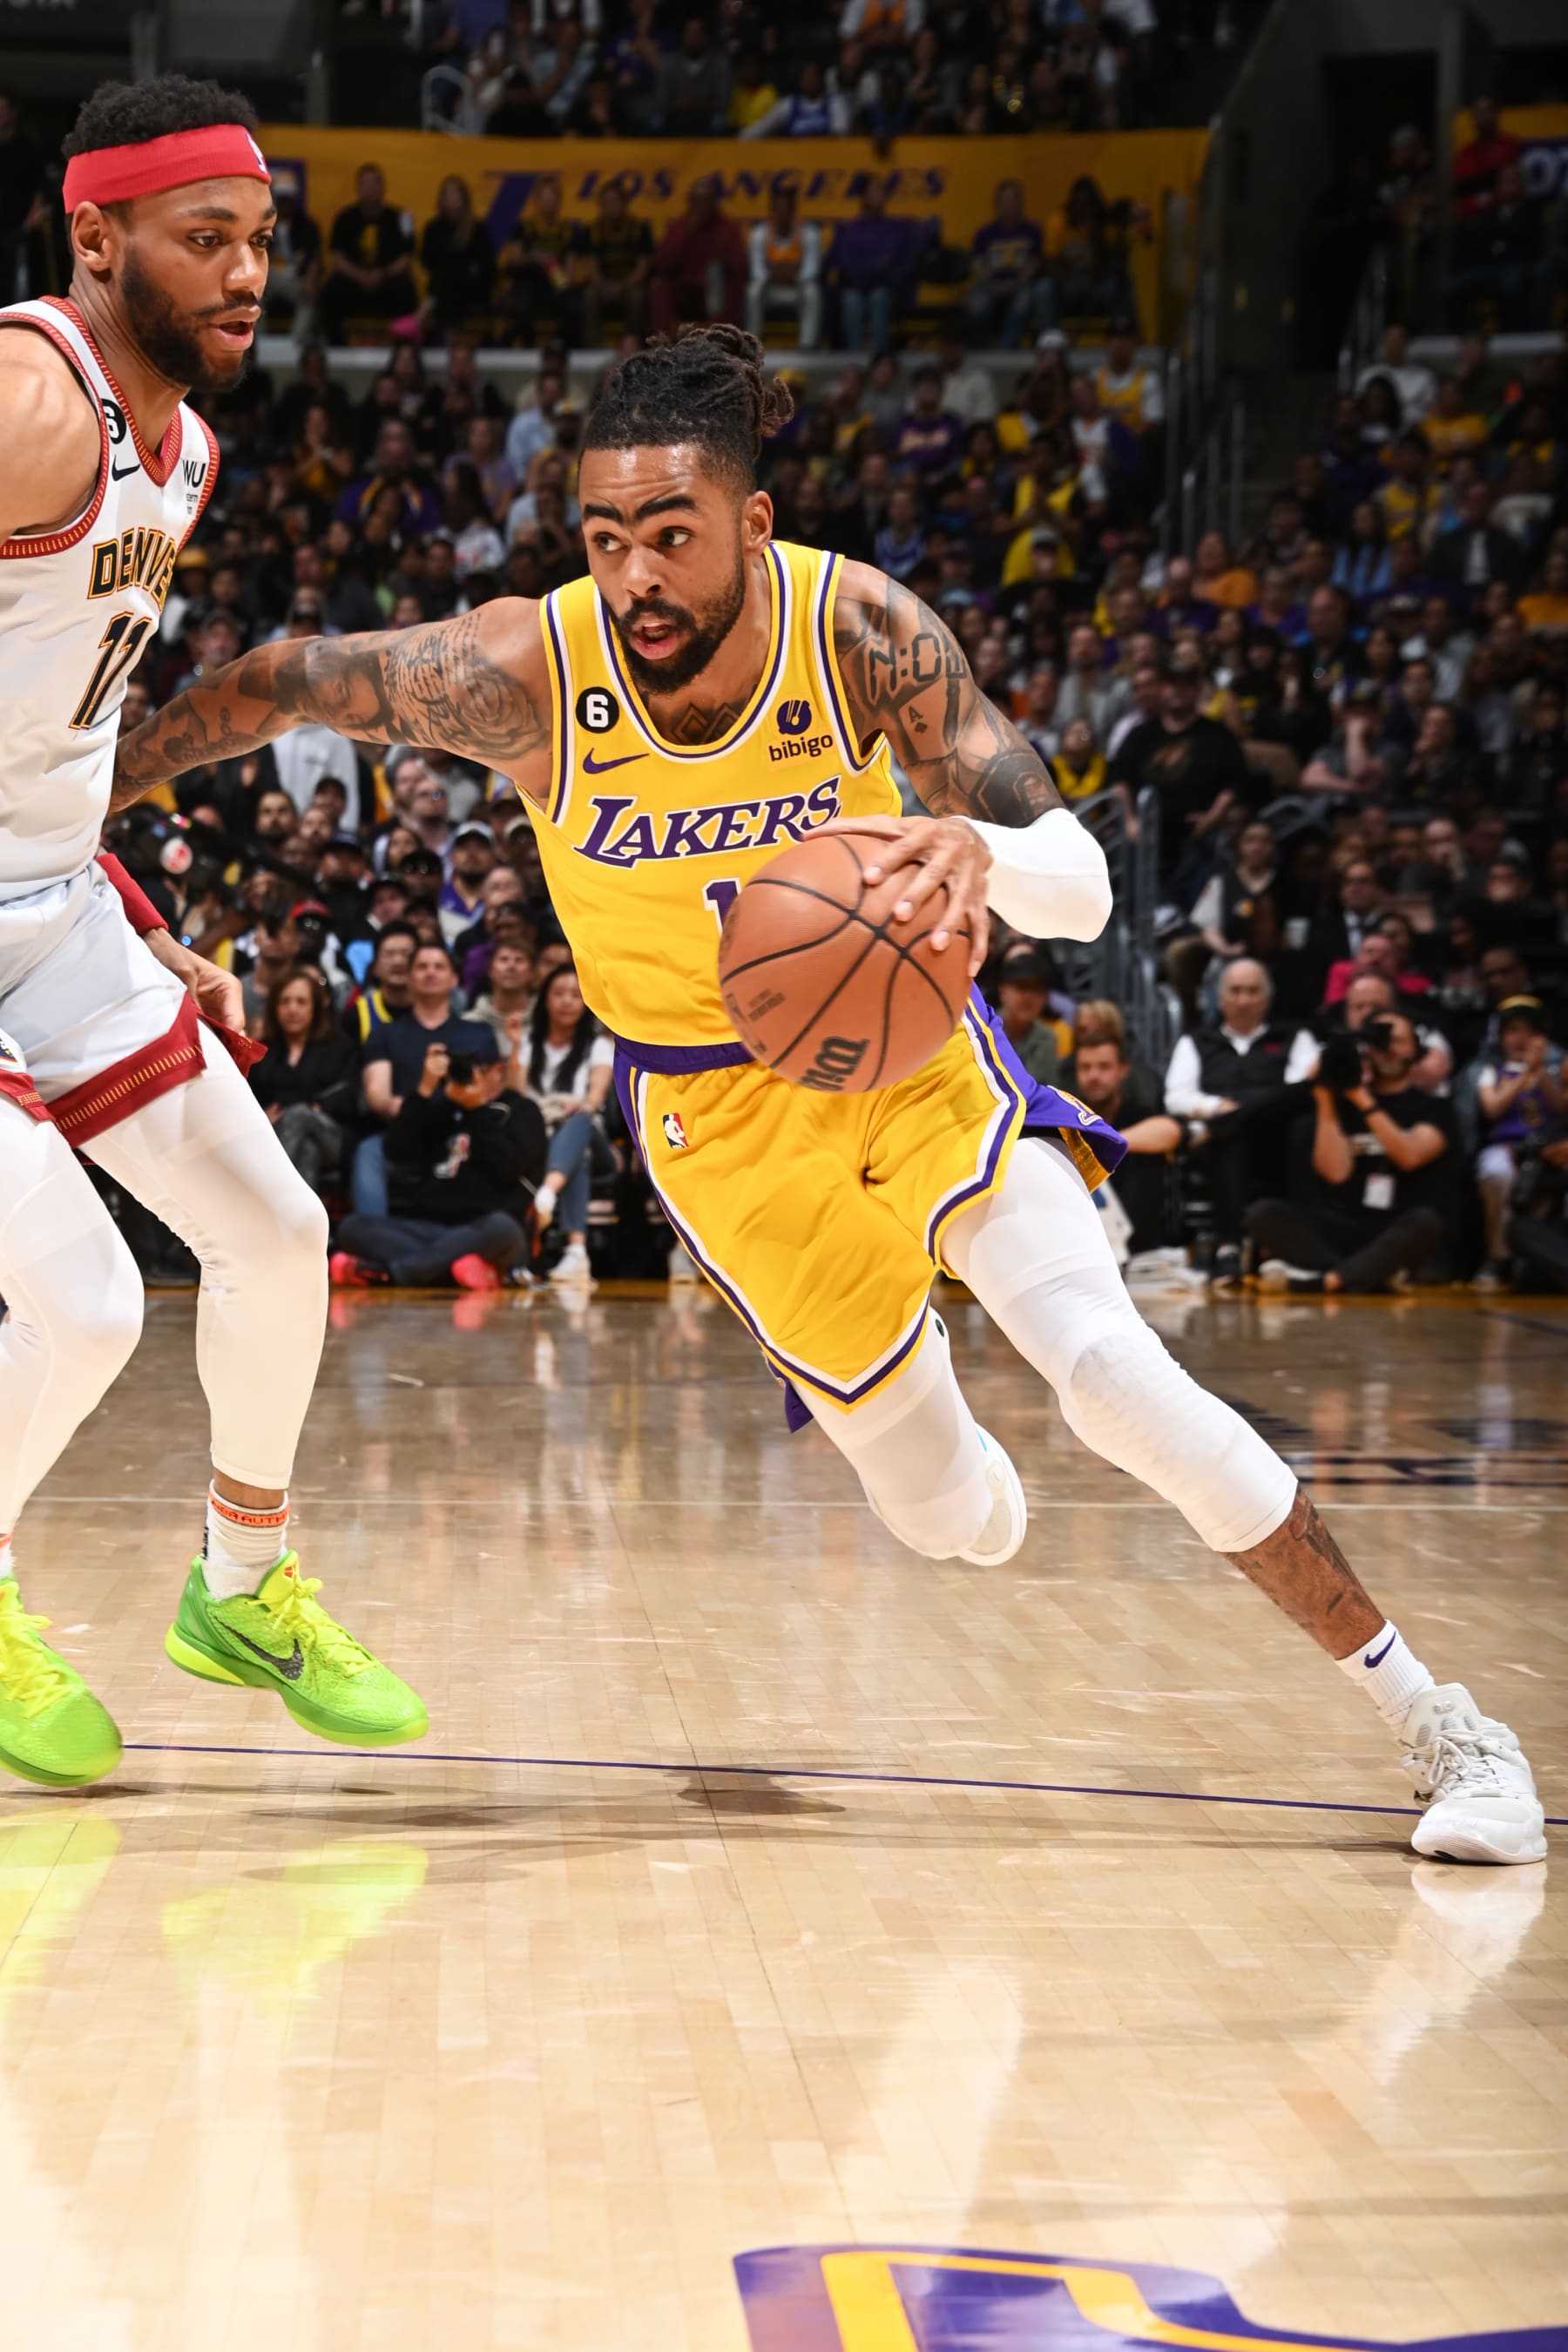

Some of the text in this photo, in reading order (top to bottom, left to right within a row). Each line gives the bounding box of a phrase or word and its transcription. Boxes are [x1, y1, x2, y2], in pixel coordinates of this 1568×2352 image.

[576, 166, 674, 200] LOS
[102, 405, 120, 440] 6
[182, 459, 206, 489] WU
[86, 526, 176, 613] DENVE
[69, 611, 152, 730] 11
[585, 693, 609, 728] 6
[767, 733, 834, 762] bibigo
[571, 774, 843, 870] LAKERS
